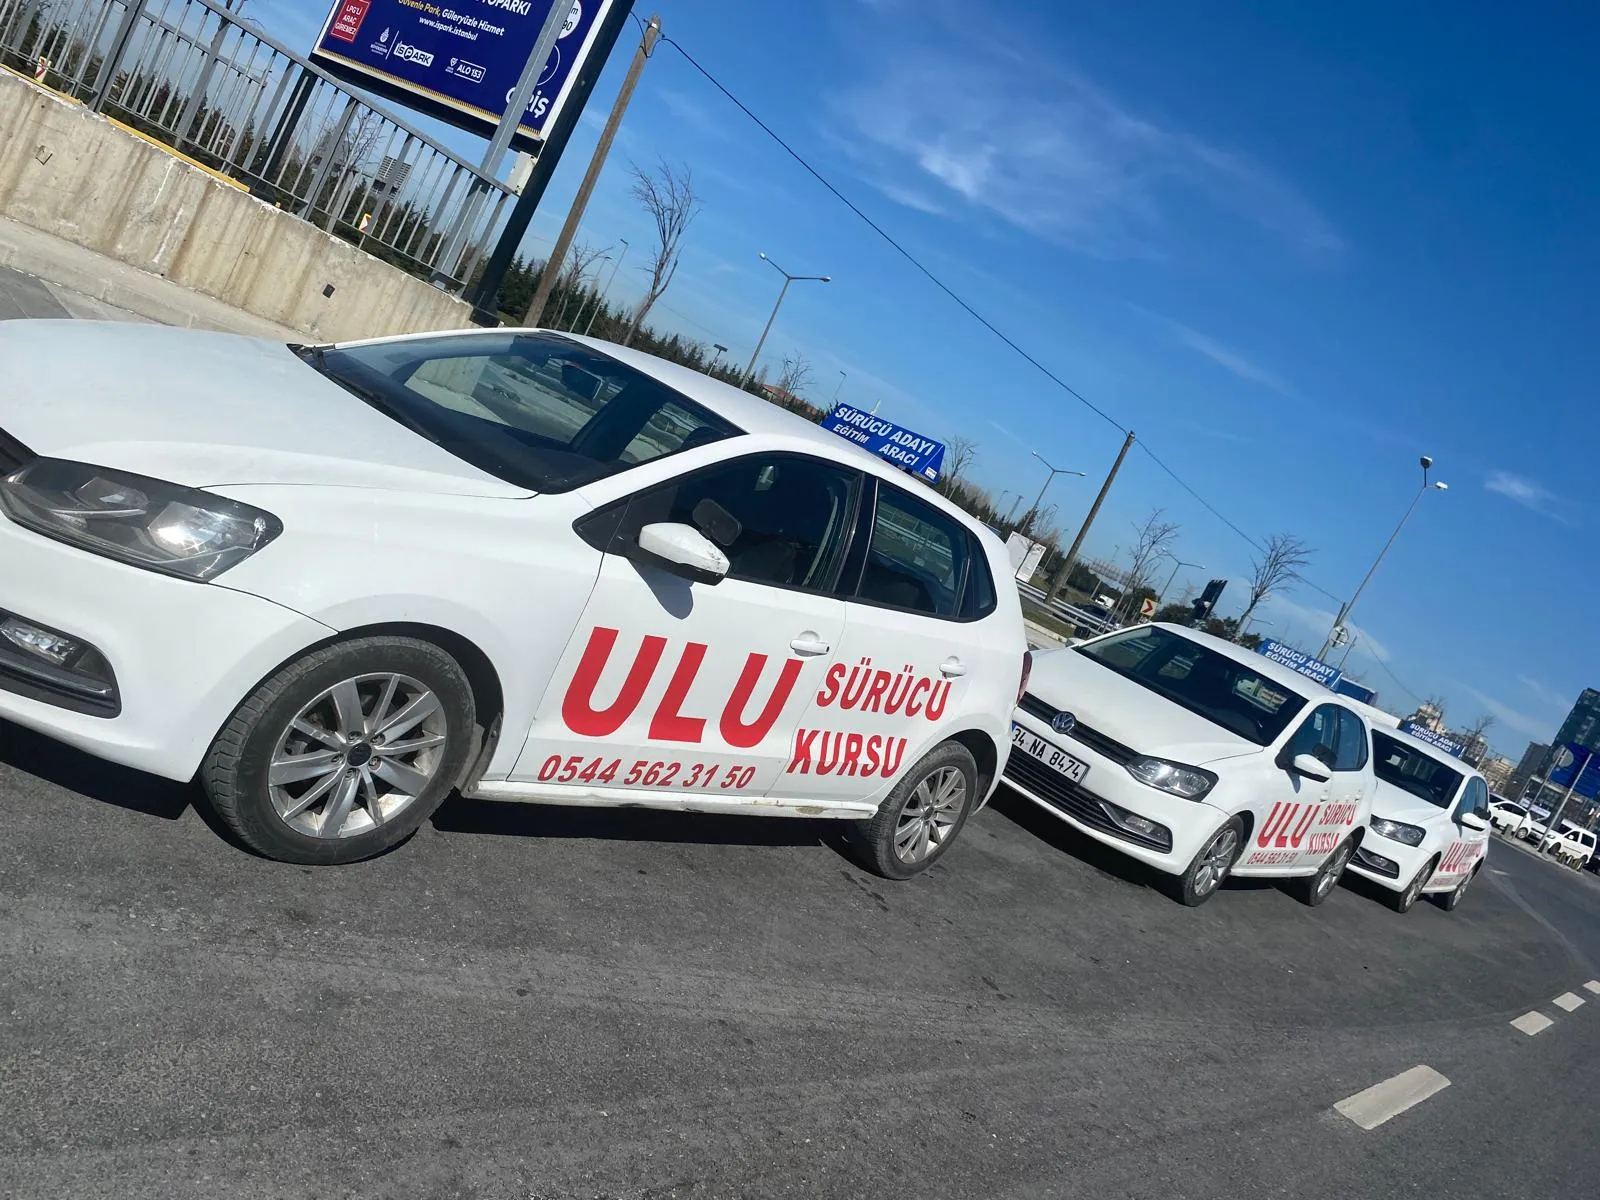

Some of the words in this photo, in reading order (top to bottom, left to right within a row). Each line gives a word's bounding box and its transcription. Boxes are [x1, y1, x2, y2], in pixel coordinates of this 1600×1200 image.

[342, 14, 357, 26] ARAÇ
[419, 17, 478, 41] www.ispark.istanbul
[442, 9, 478, 28] Güleryüzle
[478, 20, 505, 36] Hizmet
[457, 65, 471, 75] ALO
[472, 69, 482, 79] 153
[832, 423, 870, 444] EĞİTİM
[878, 443, 920, 466] ARACI
[835, 407, 892, 437] SÜRÜCÜ
[889, 431, 936, 456] ADAYI
[1265, 651, 1298, 670] EĞİTİM
[1297, 666, 1327, 683] ARACI
[1304, 660, 1335, 677] ADAYI
[561, 626, 804, 748] ULU
[786, 728, 907, 779] KURSU
[1012, 728, 1026, 746] 34
[1029, 738, 1047, 759] NA
[1049, 751, 1081, 779] 8474
[537, 754, 622, 784] 0544
[623, 760, 681, 787] 562
[682, 764, 720, 788] 31
[720, 766, 756, 789] 50
[1257, 801, 1320, 849] ULU
[1306, 832, 1340, 856] KURSU
